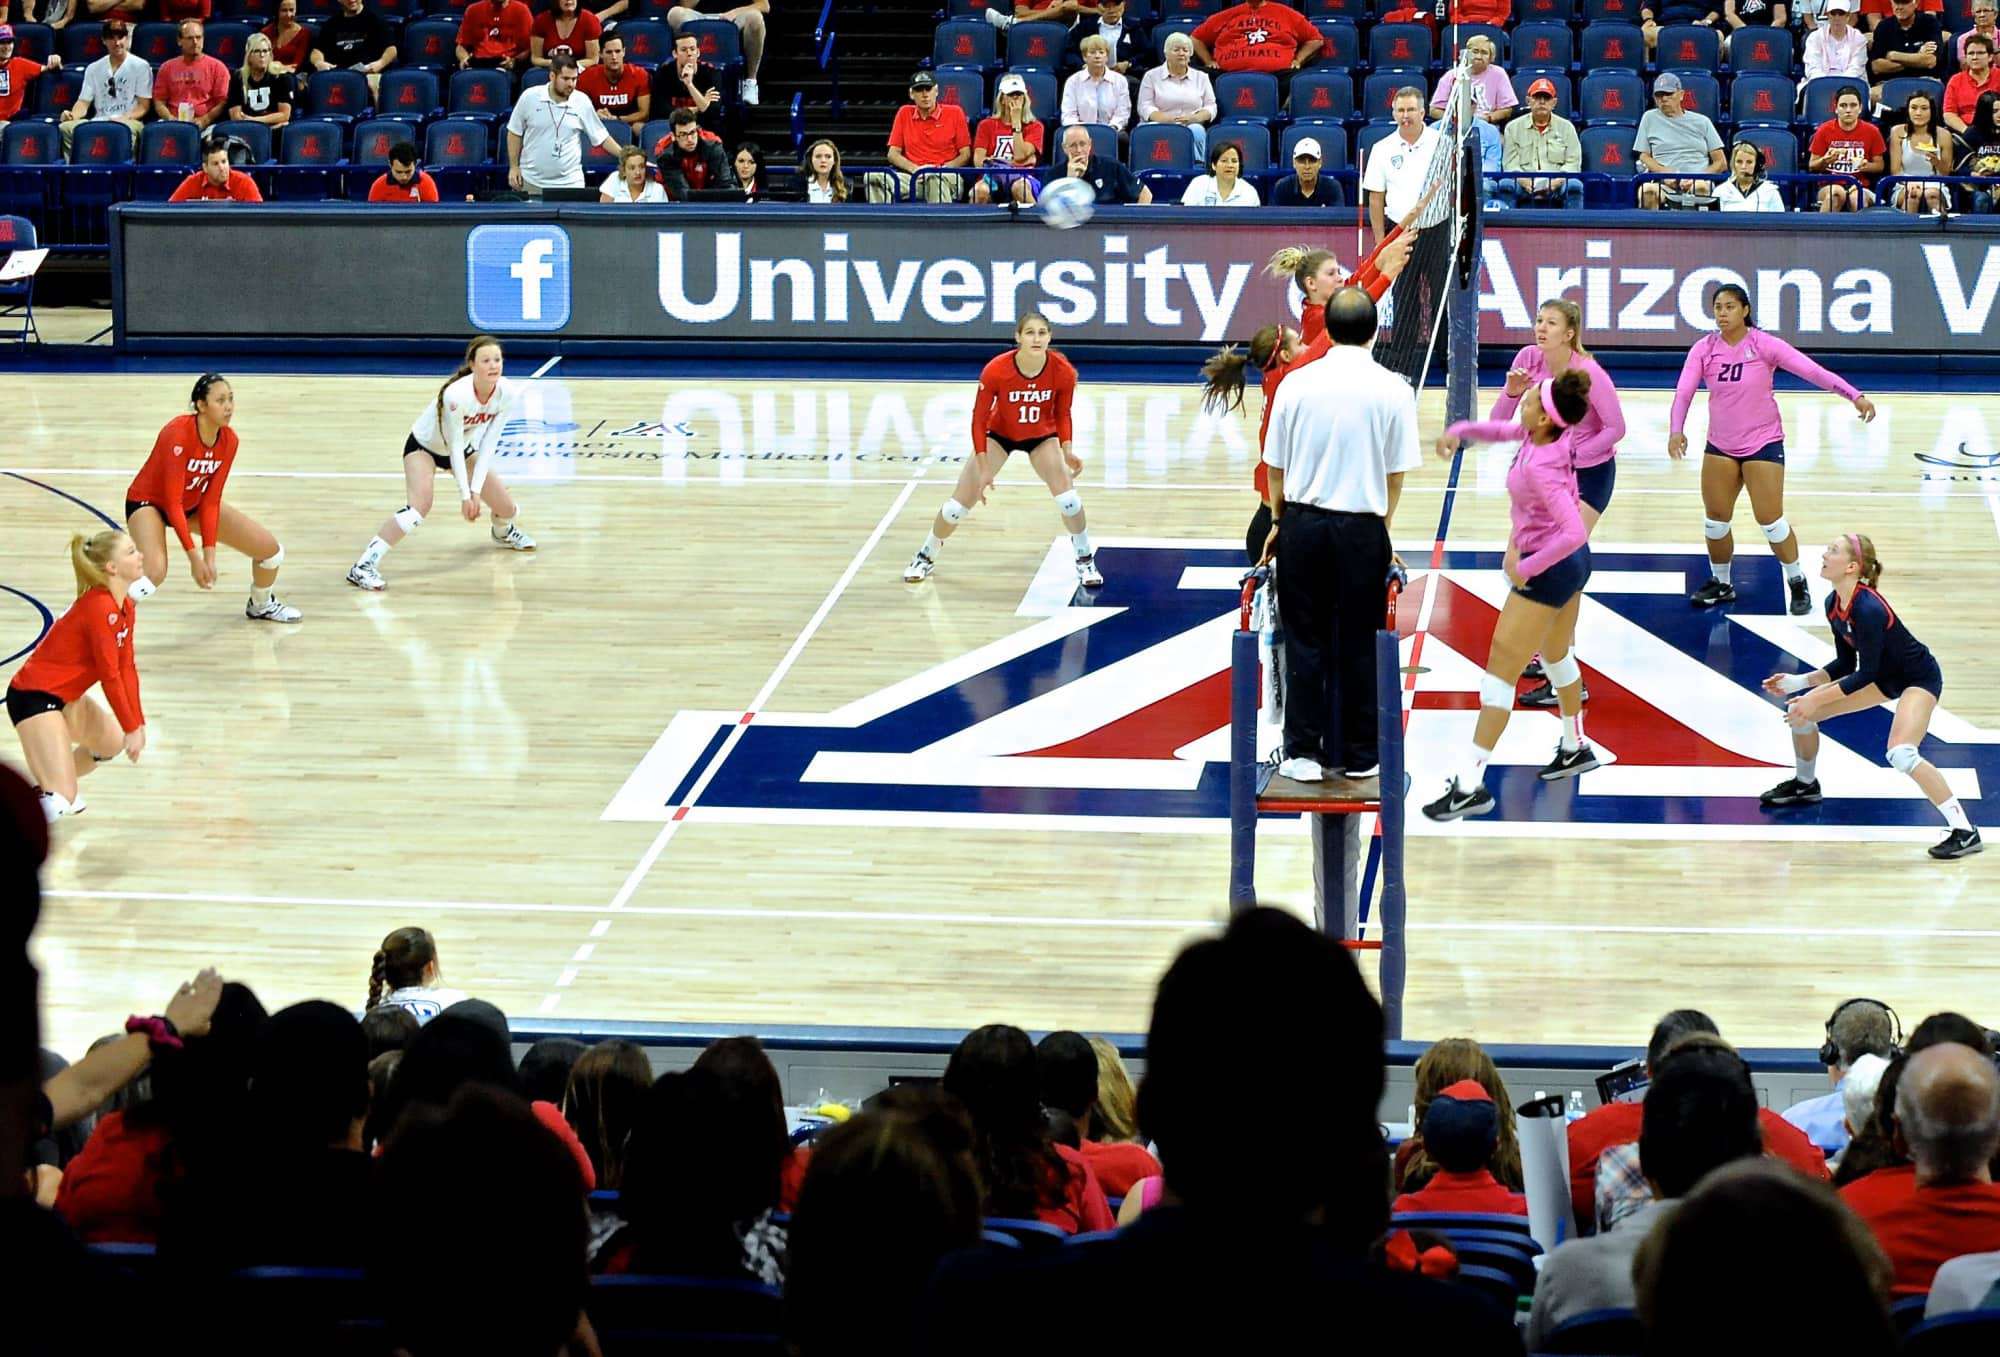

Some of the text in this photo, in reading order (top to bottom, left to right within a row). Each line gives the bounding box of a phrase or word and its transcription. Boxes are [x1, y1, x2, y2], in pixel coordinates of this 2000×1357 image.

[248, 86, 271, 112] U
[599, 94, 628, 106] UTAH
[657, 231, 1253, 342] University
[1478, 238, 1893, 335] Arizona
[1717, 363, 1743, 382] 20
[1008, 390, 1052, 403] UTAH
[1018, 405, 1041, 424] 10
[683, 451, 843, 462] Medical
